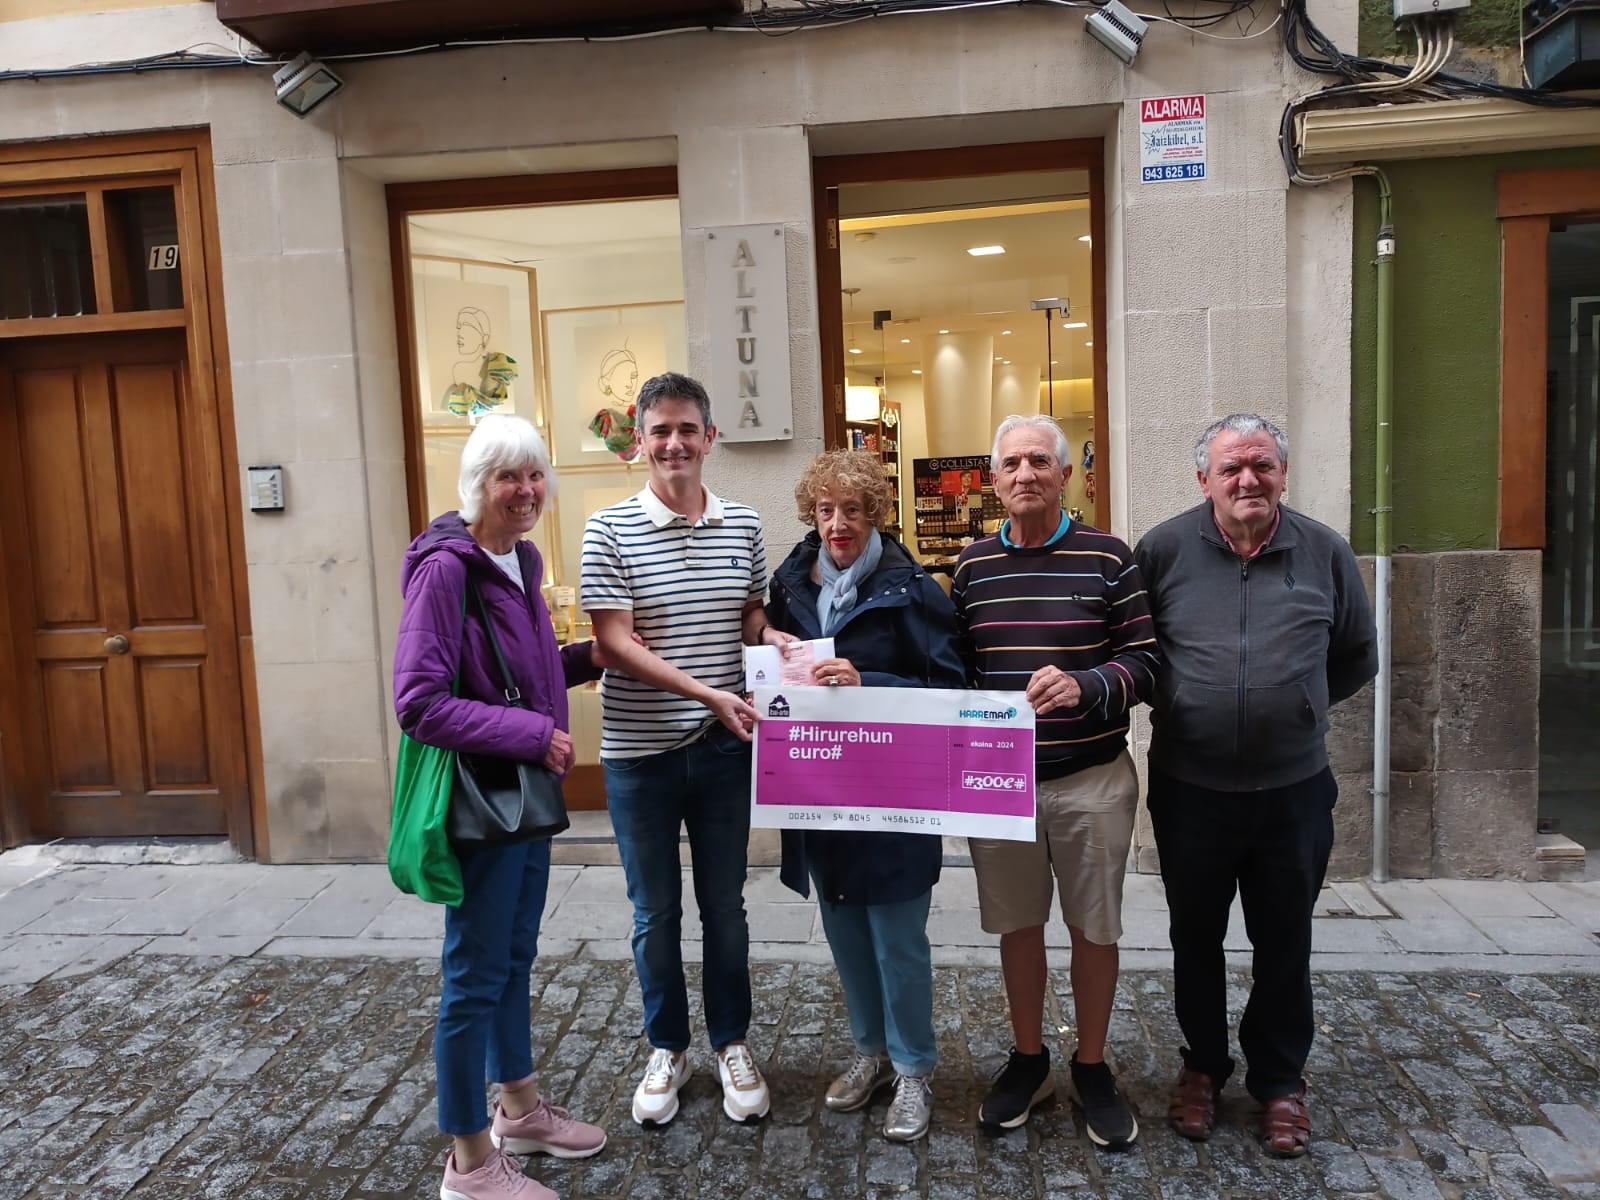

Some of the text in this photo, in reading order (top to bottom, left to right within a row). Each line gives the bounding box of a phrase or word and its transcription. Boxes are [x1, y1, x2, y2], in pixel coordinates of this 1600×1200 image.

[1144, 97, 1203, 119] ALARMA
[1144, 164, 1204, 180] 943 625 181
[153, 246, 176, 268] 19
[731, 238, 763, 429] ALTUNA
[959, 709, 1011, 720] HARREMAN
[788, 725, 893, 744] #Hirurehun
[788, 744, 843, 760] euro#
[970, 740, 993, 748] ekaina
[996, 741, 1015, 749] 2024
[964, 775, 1026, 790] #300€#
[788, 812, 822, 821] 002154
[832, 813, 844, 821] 54
[849, 814, 871, 822] 8045
[930, 817, 942, 826] 01
